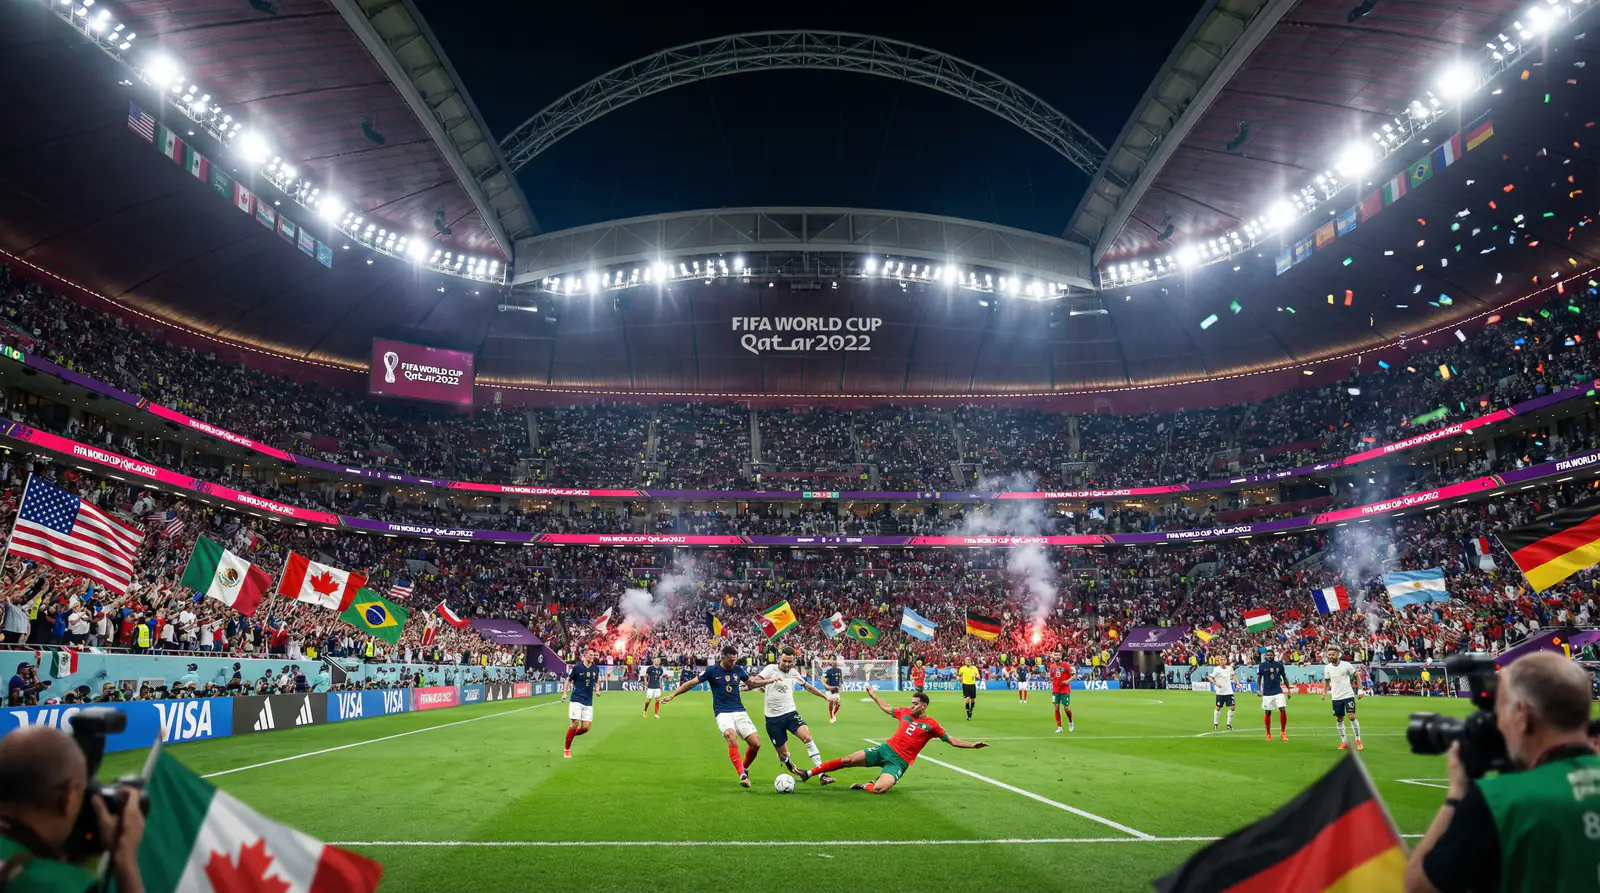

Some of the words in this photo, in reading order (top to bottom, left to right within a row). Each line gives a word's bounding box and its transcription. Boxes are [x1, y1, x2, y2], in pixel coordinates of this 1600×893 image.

[732, 317, 772, 331] FIFA
[774, 317, 842, 331] WORLD
[845, 317, 883, 332] CUP
[401, 362, 419, 372] FIFA
[419, 365, 448, 376] WORLD
[448, 369, 463, 377] CUP
[73, 445, 88, 457] FIFA
[88, 448, 109, 462] WORLD
[109, 455, 120, 464] CUP
[1556, 460, 1571, 471] FIFA
[1571, 454, 1597, 467] WORLD
[400, 525, 420, 533] WORLD
[726, 683, 733, 693] 6
[1083, 680, 1109, 690] VISA
[336, 692, 363, 719] VISA
[383, 689, 404, 714] VISA
[1347, 701, 1355, 709] 10
[152, 700, 212, 743] VISA
[905, 722, 917, 736] 2
